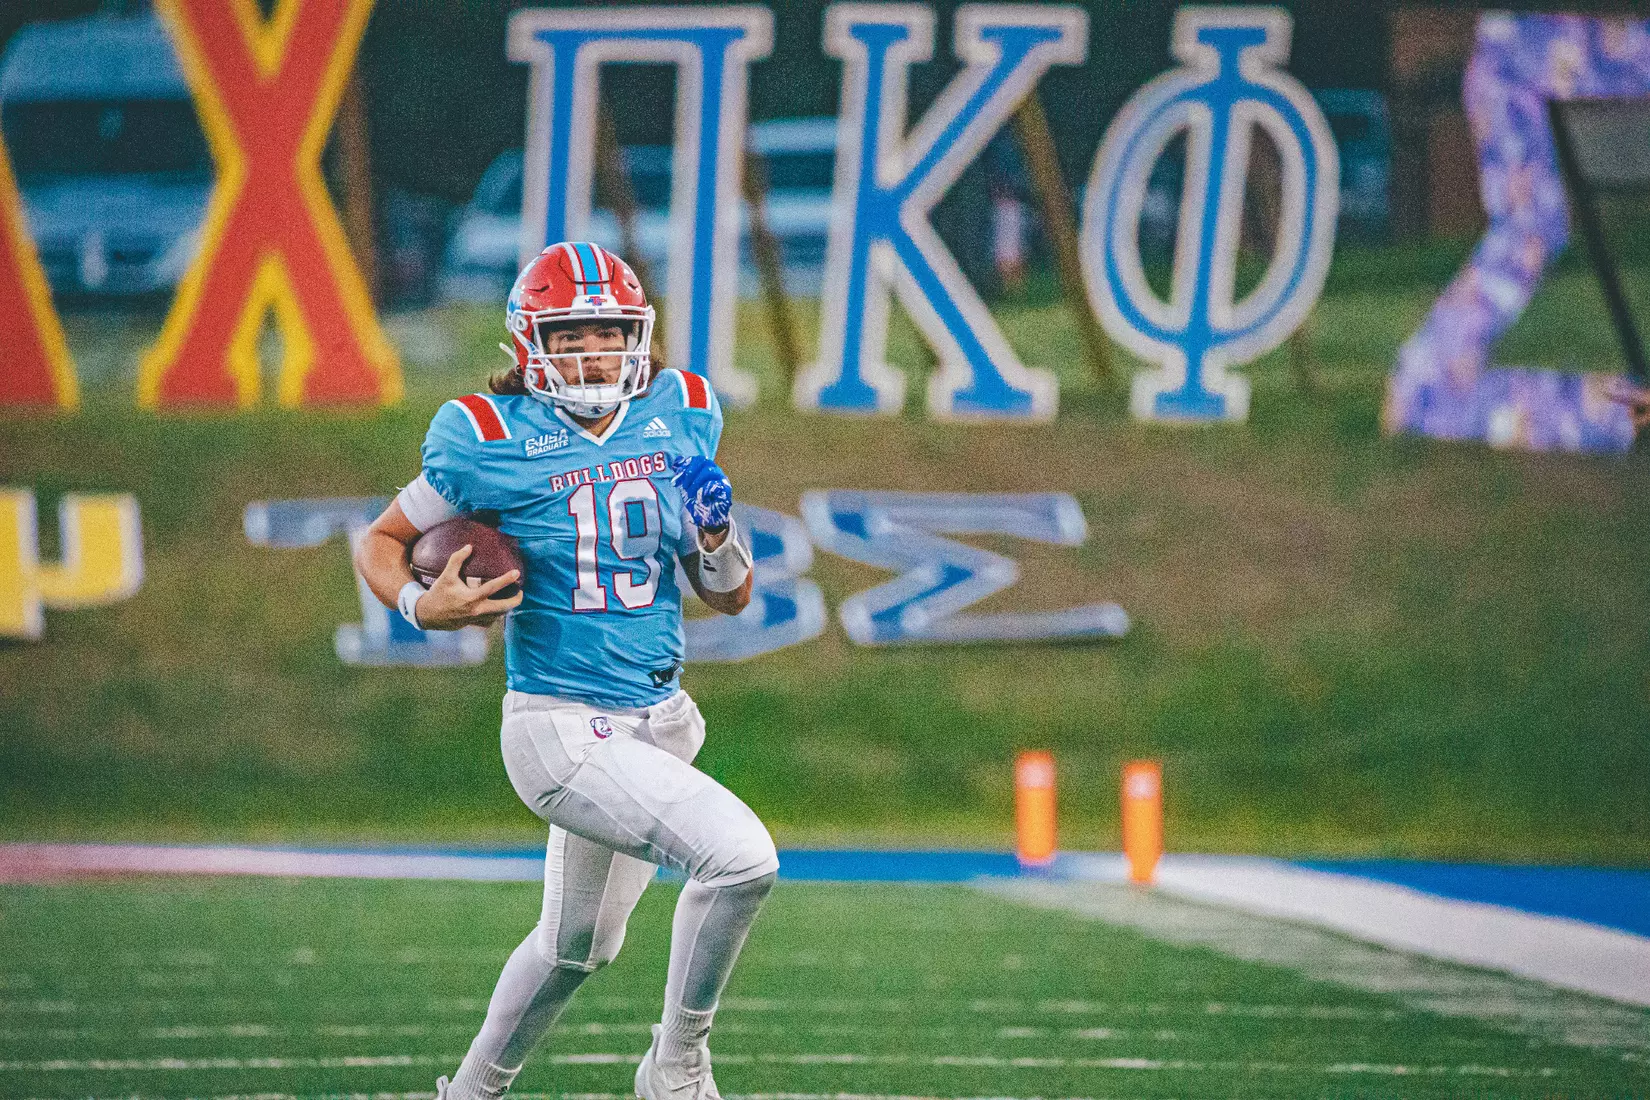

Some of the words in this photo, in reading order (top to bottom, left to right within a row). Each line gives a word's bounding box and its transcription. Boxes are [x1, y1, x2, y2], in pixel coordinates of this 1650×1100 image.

[527, 439, 569, 457] GRADUATE
[643, 430, 671, 439] adidas
[549, 451, 666, 493] BULLDOGS
[568, 477, 662, 613] 19
